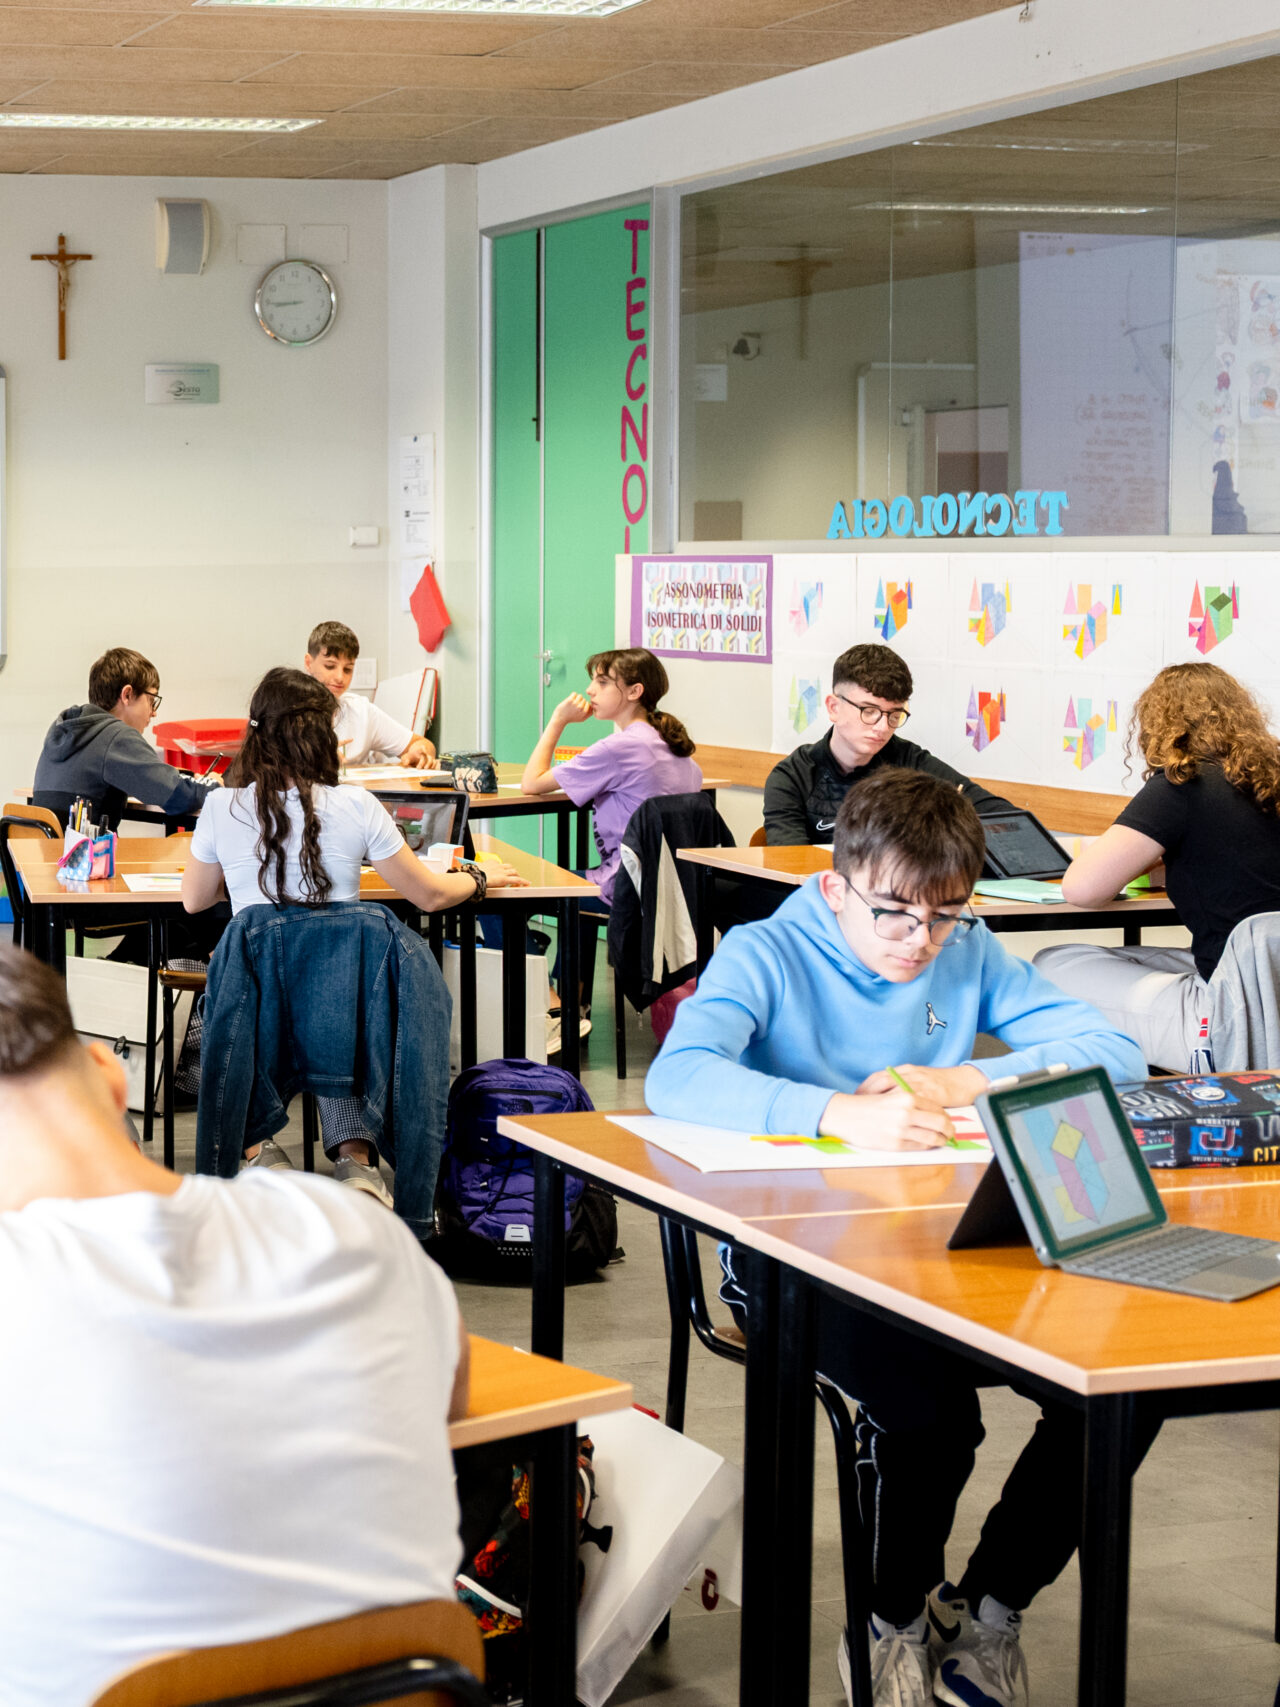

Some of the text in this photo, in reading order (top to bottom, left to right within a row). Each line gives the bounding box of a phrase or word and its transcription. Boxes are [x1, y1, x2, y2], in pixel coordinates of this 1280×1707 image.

[664, 582, 743, 600] ASSONOMETRIA
[647, 611, 762, 632] ISOMETRICA DI SOLIDI
